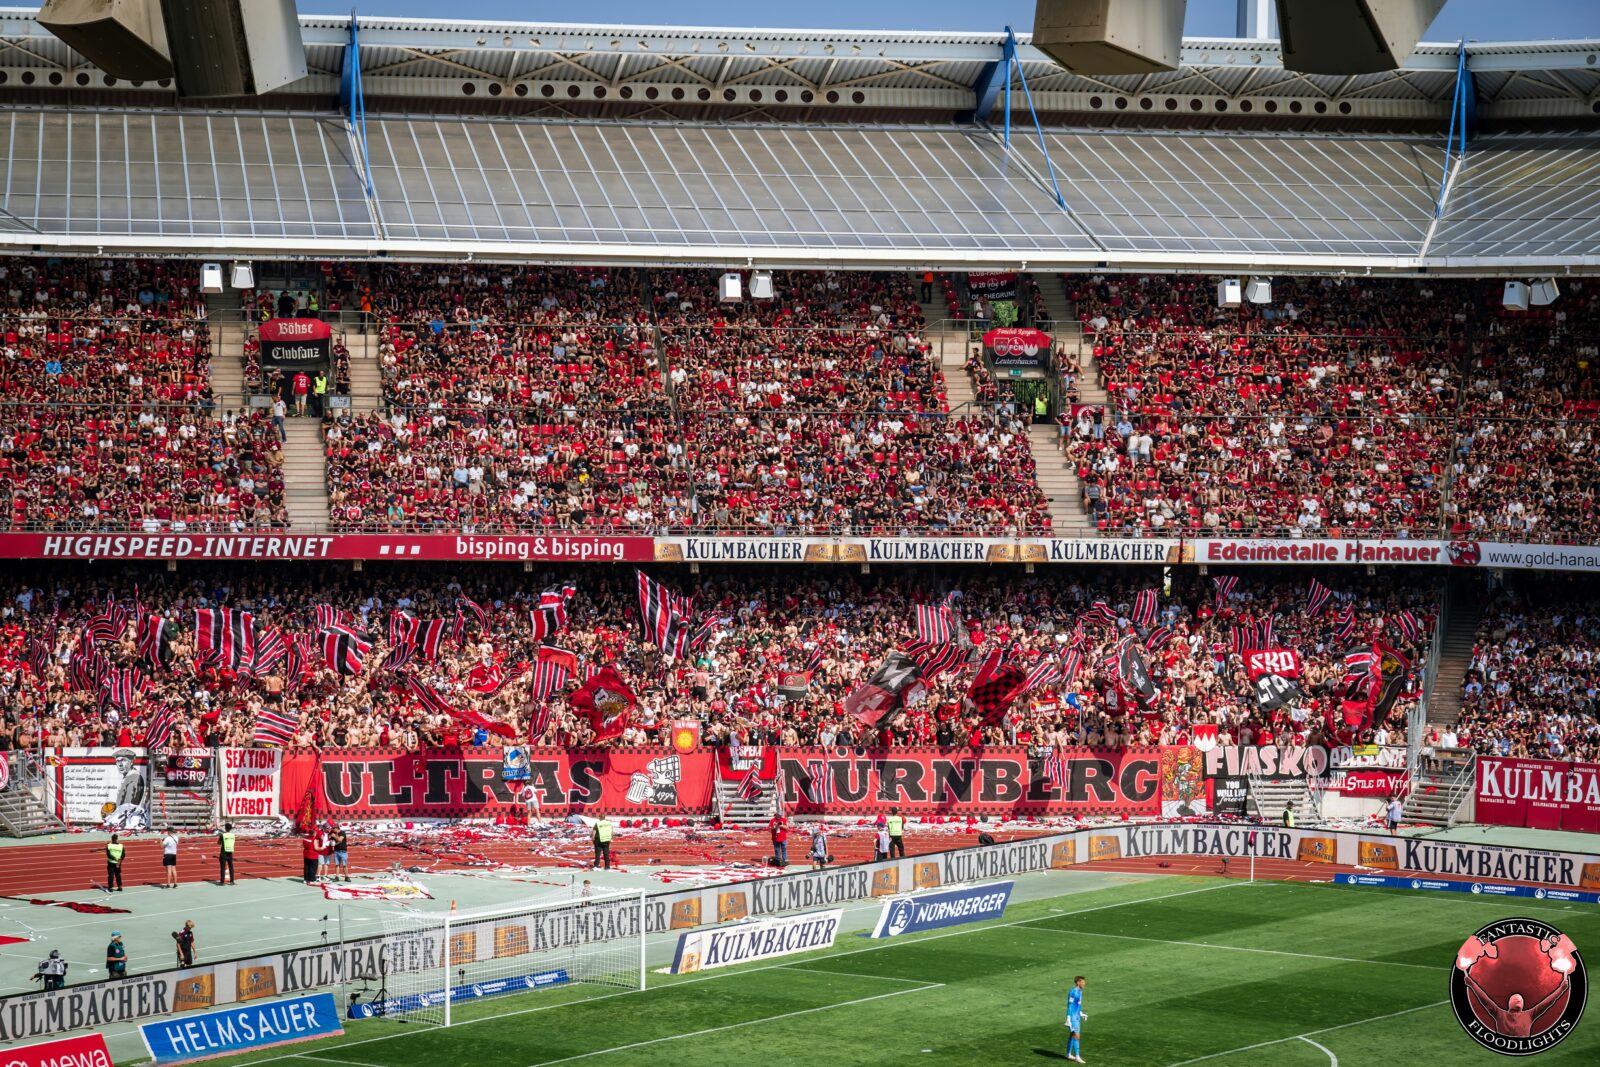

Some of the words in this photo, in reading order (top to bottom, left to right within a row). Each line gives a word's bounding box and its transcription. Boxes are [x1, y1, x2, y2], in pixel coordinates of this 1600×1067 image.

[278, 322, 313, 335] Böhse
[272, 346, 320, 359] Clubfanz
[43, 536, 333, 557] HIGHSPEED-INTERNET
[456, 537, 529, 560] bisping
[533, 538, 548, 555] &
[552, 538, 625, 560] bisping
[686, 539, 803, 560] KULMBACHER
[870, 539, 984, 560] KULMBACHER
[1050, 540, 1165, 561] KULMBACHER
[1345, 543, 1441, 561] Hanauer
[225, 749, 275, 769] SEKTION
[1206, 744, 1328, 776] FIASKO
[176, 770, 196, 780] RSR
[226, 774, 273, 793] STADION
[321, 759, 606, 807] ULTRAS
[780, 747, 1161, 804] NÜRNBERG
[1225, 781, 1240, 789] YOU
[1480, 760, 1600, 804] KULMBA
[656, 791, 675, 801] 1994
[1216, 789, 1233, 797] WILL
[227, 798, 273, 816] VERBOT
[1125, 826, 1292, 858] KULMBACHER
[943, 843, 1048, 884] KULMBACHER
[1404, 839, 1575, 886] KULMBACHER
[751, 870, 868, 915] KULMBACHER
[915, 892, 1006, 924] NÜRNBERGER
[533, 901, 666, 951] KULMBACHER
[704, 918, 837, 965] KULMBACHER
[281, 937, 435, 992] KULMBACHER
[166, 1001, 321, 1054] HELMSAUER
